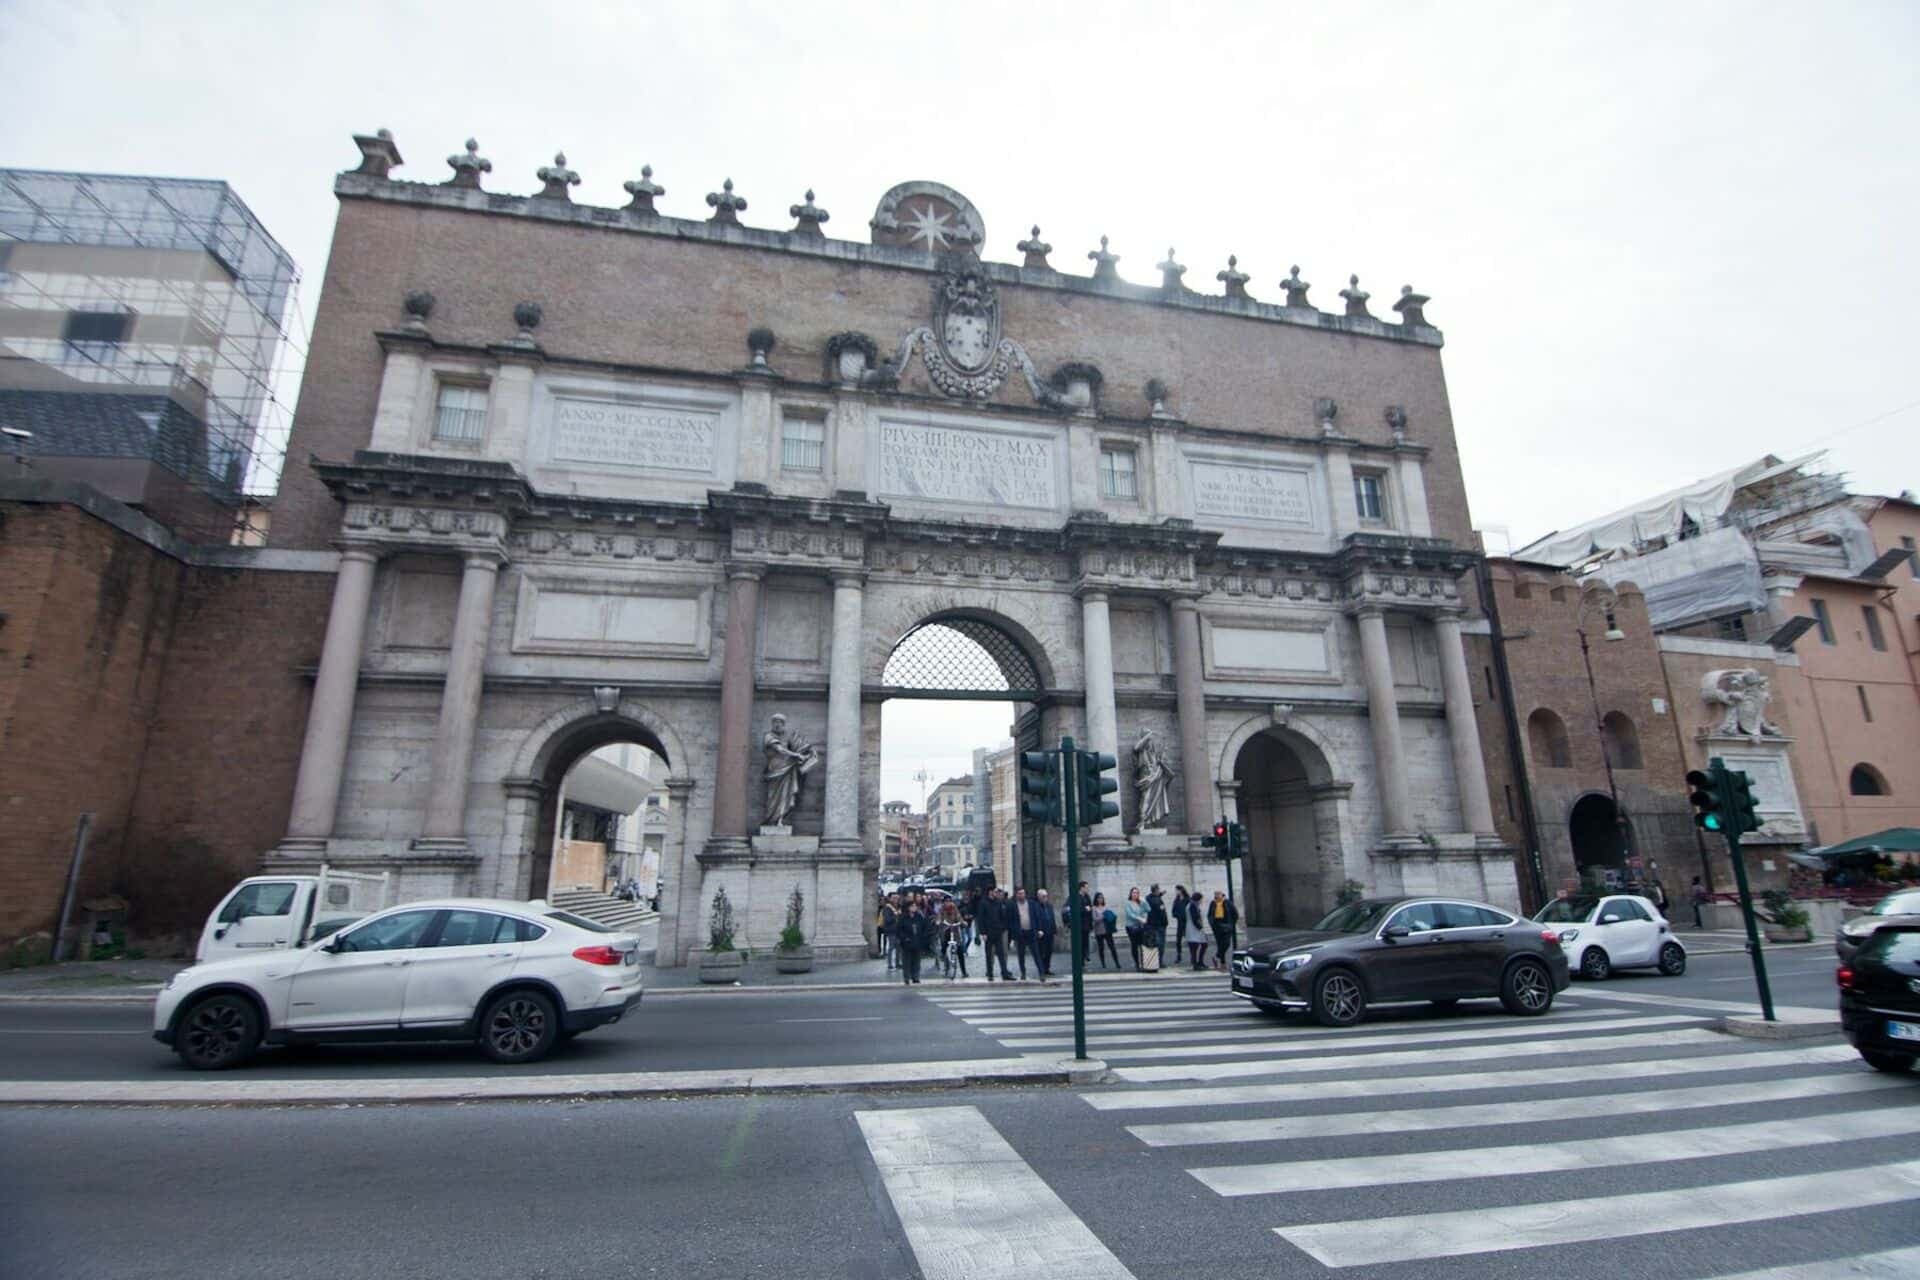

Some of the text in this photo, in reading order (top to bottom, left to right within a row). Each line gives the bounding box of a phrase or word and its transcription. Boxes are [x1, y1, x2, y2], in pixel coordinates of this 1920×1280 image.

[560, 408, 606, 422] ANNO
[884, 427, 920, 444] PIVS
[952, 434, 1000, 452] PONT
[1008, 440, 1047, 457] MAX
